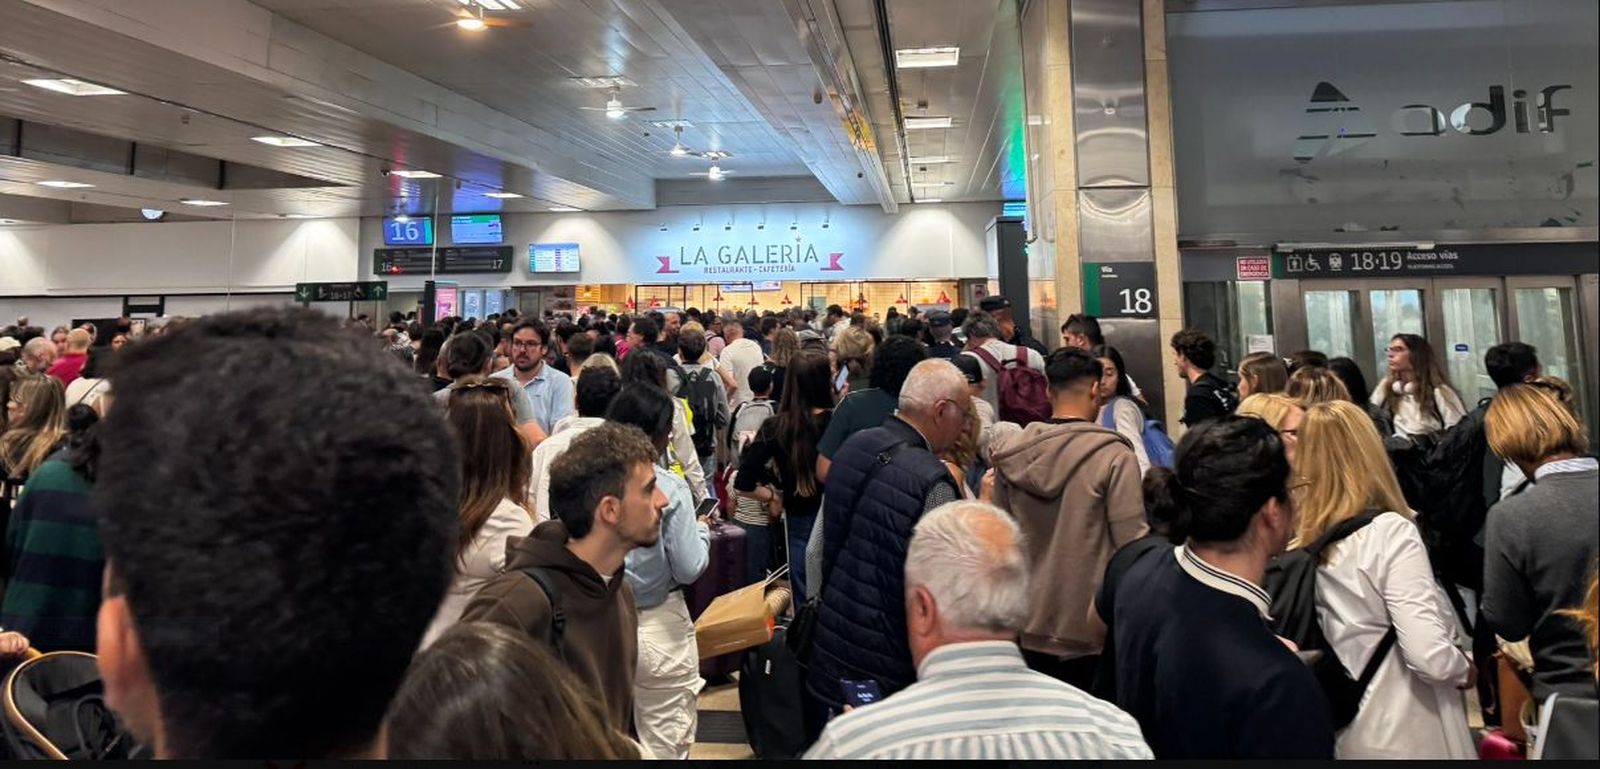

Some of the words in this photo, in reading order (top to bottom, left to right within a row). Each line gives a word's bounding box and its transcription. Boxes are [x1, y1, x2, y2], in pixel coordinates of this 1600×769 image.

[1396, 85, 1572, 136] adif
[391, 221, 419, 241] 16
[680, 246, 708, 265] LA
[718, 238, 819, 265] GALERÍA
[1407, 251, 1437, 261] Acceso
[492, 259, 504, 269] 17
[1119, 288, 1152, 314] 18
